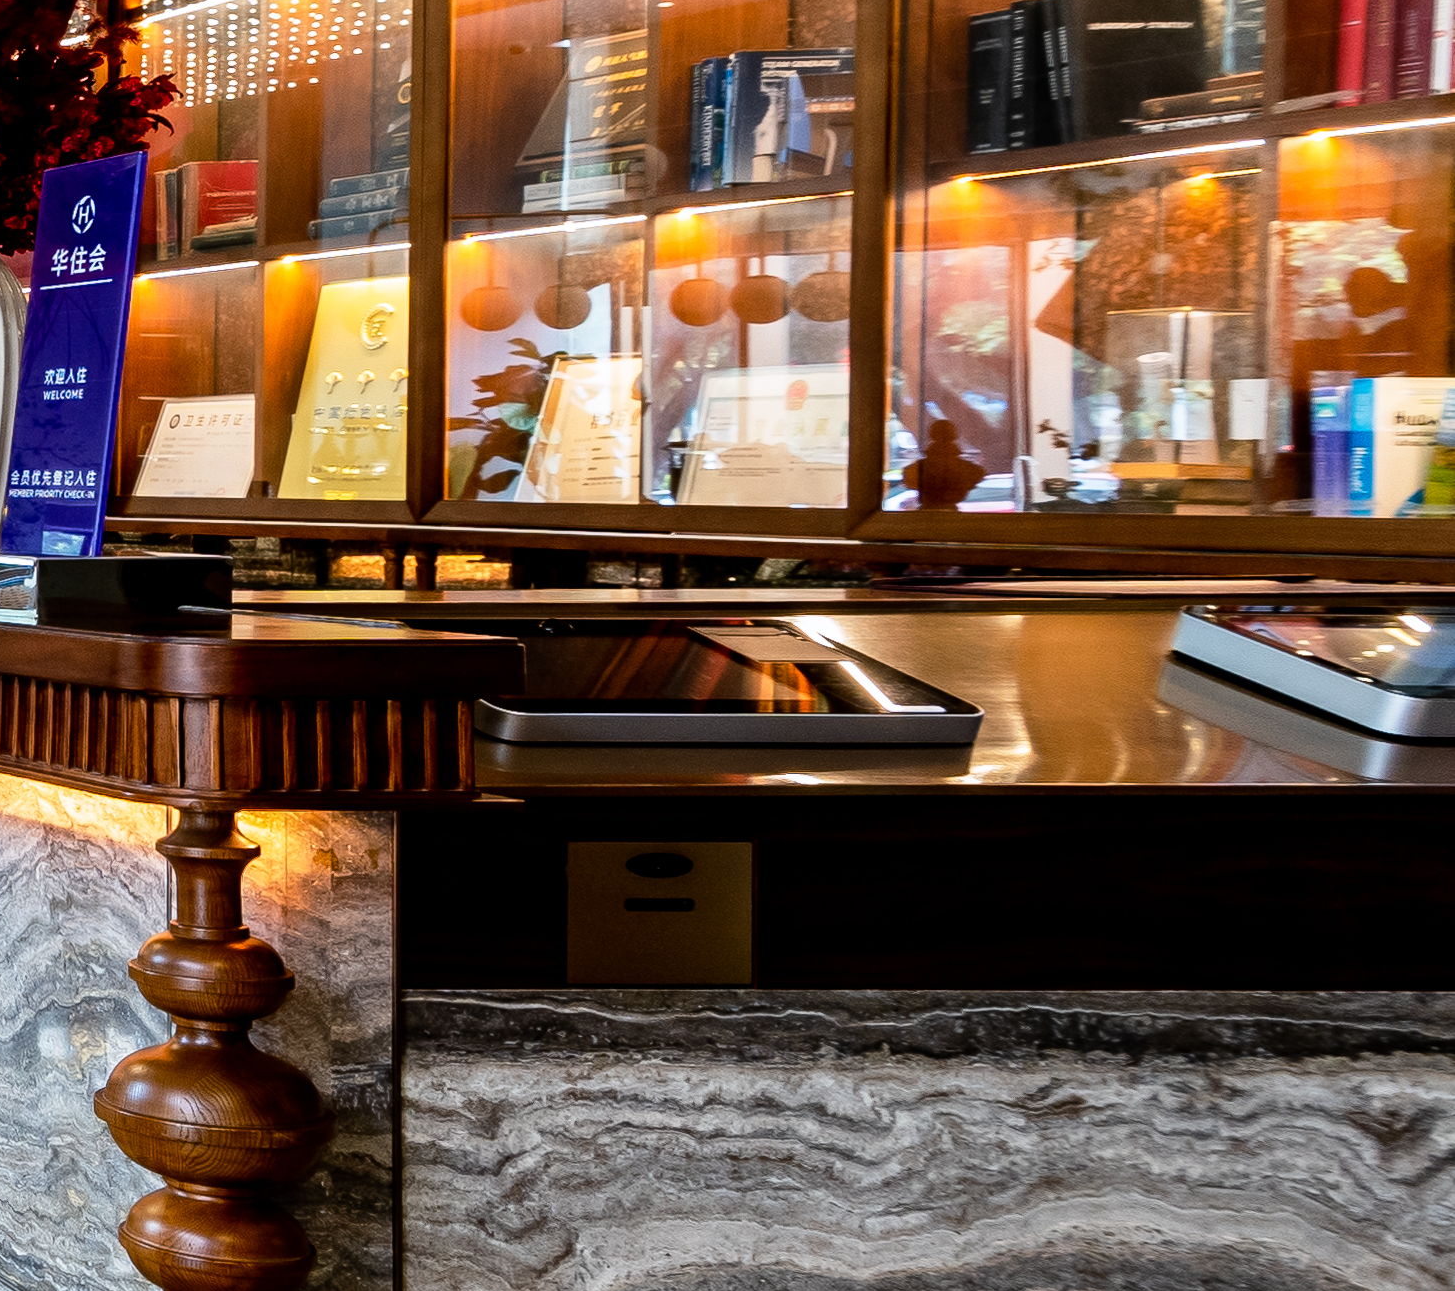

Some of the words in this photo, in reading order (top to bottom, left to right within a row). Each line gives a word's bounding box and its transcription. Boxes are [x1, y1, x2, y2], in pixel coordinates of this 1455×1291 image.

[51, 243, 107, 277] 华住会
[43, 366, 88, 385] 欢迎入住
[42, 389, 84, 401] WELCOME
[10, 470, 97, 486] 会员优先登记入住
[8, 489, 34, 498] MEMBER
[34, 489, 64, 498] PRIORITY
[64, 490, 95, 499] CHECK-IN
